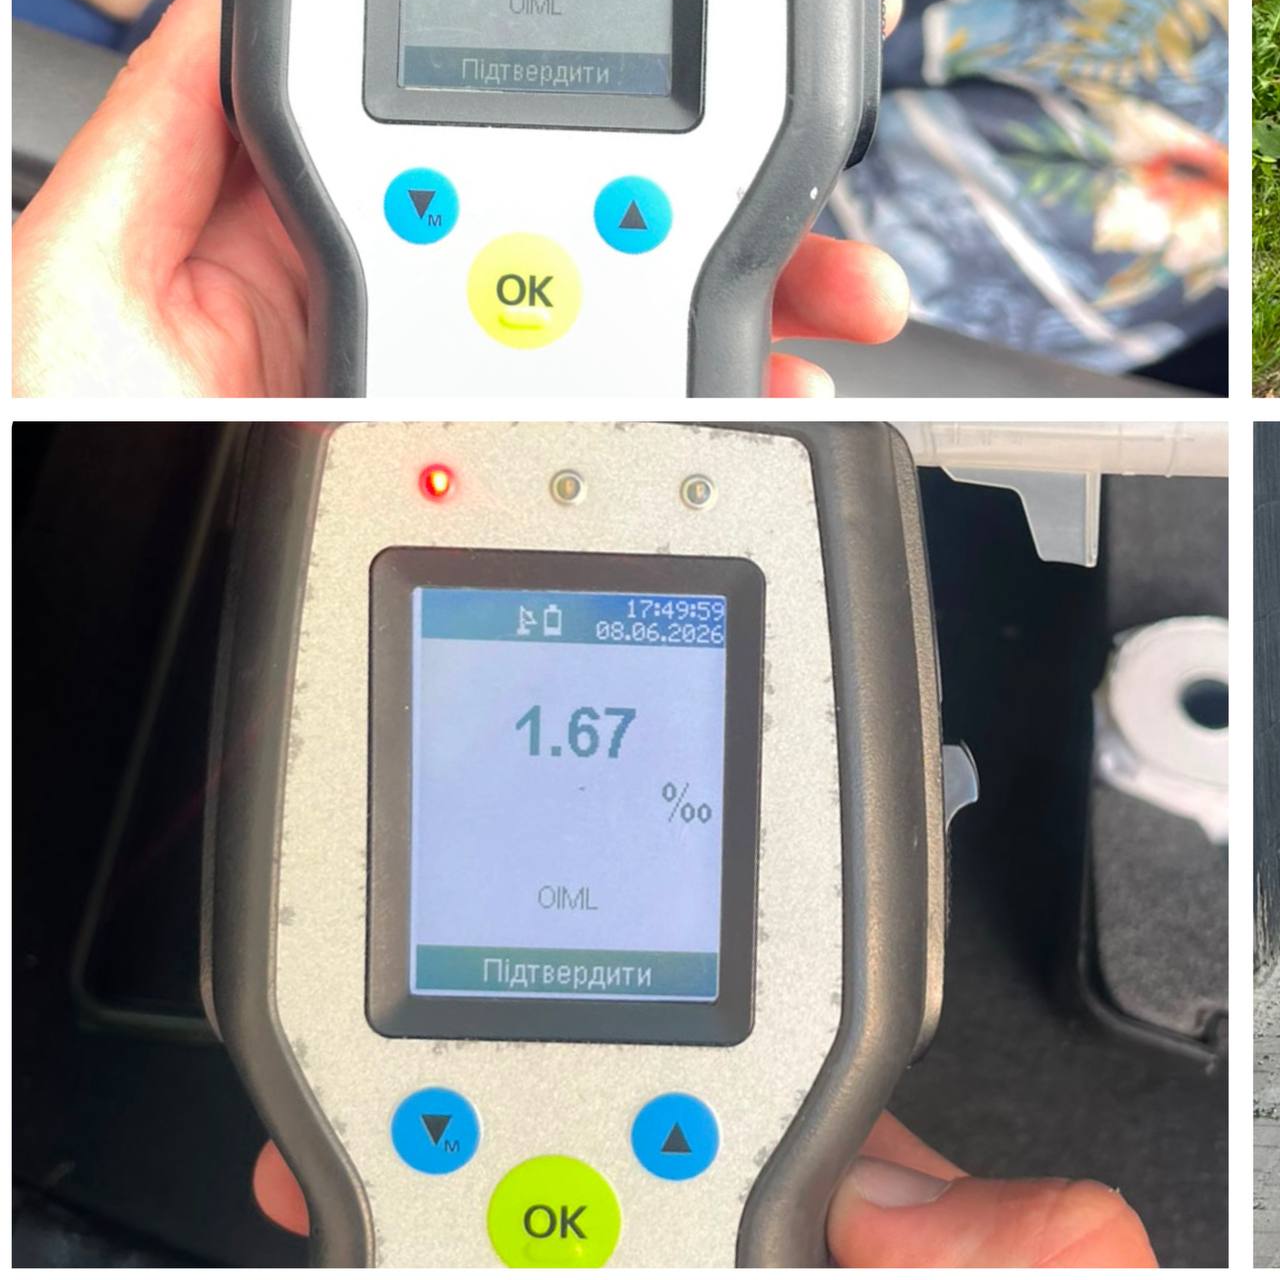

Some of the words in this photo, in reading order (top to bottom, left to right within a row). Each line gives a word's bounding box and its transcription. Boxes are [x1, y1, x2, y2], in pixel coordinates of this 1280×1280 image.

[462, 57, 610, 86] Підтвердити
[428, 214, 441, 227] M
[496, 274, 553, 308] OK
[626, 600, 724, 620] 17:49:59
[596, 621, 724, 644] 08.06.2026
[515, 705, 637, 759] 1.67
[537, 885, 598, 911] OIML
[483, 958, 652, 989] Підтвердити
[444, 1140, 460, 1153] M
[523, 1204, 587, 1239] OK
